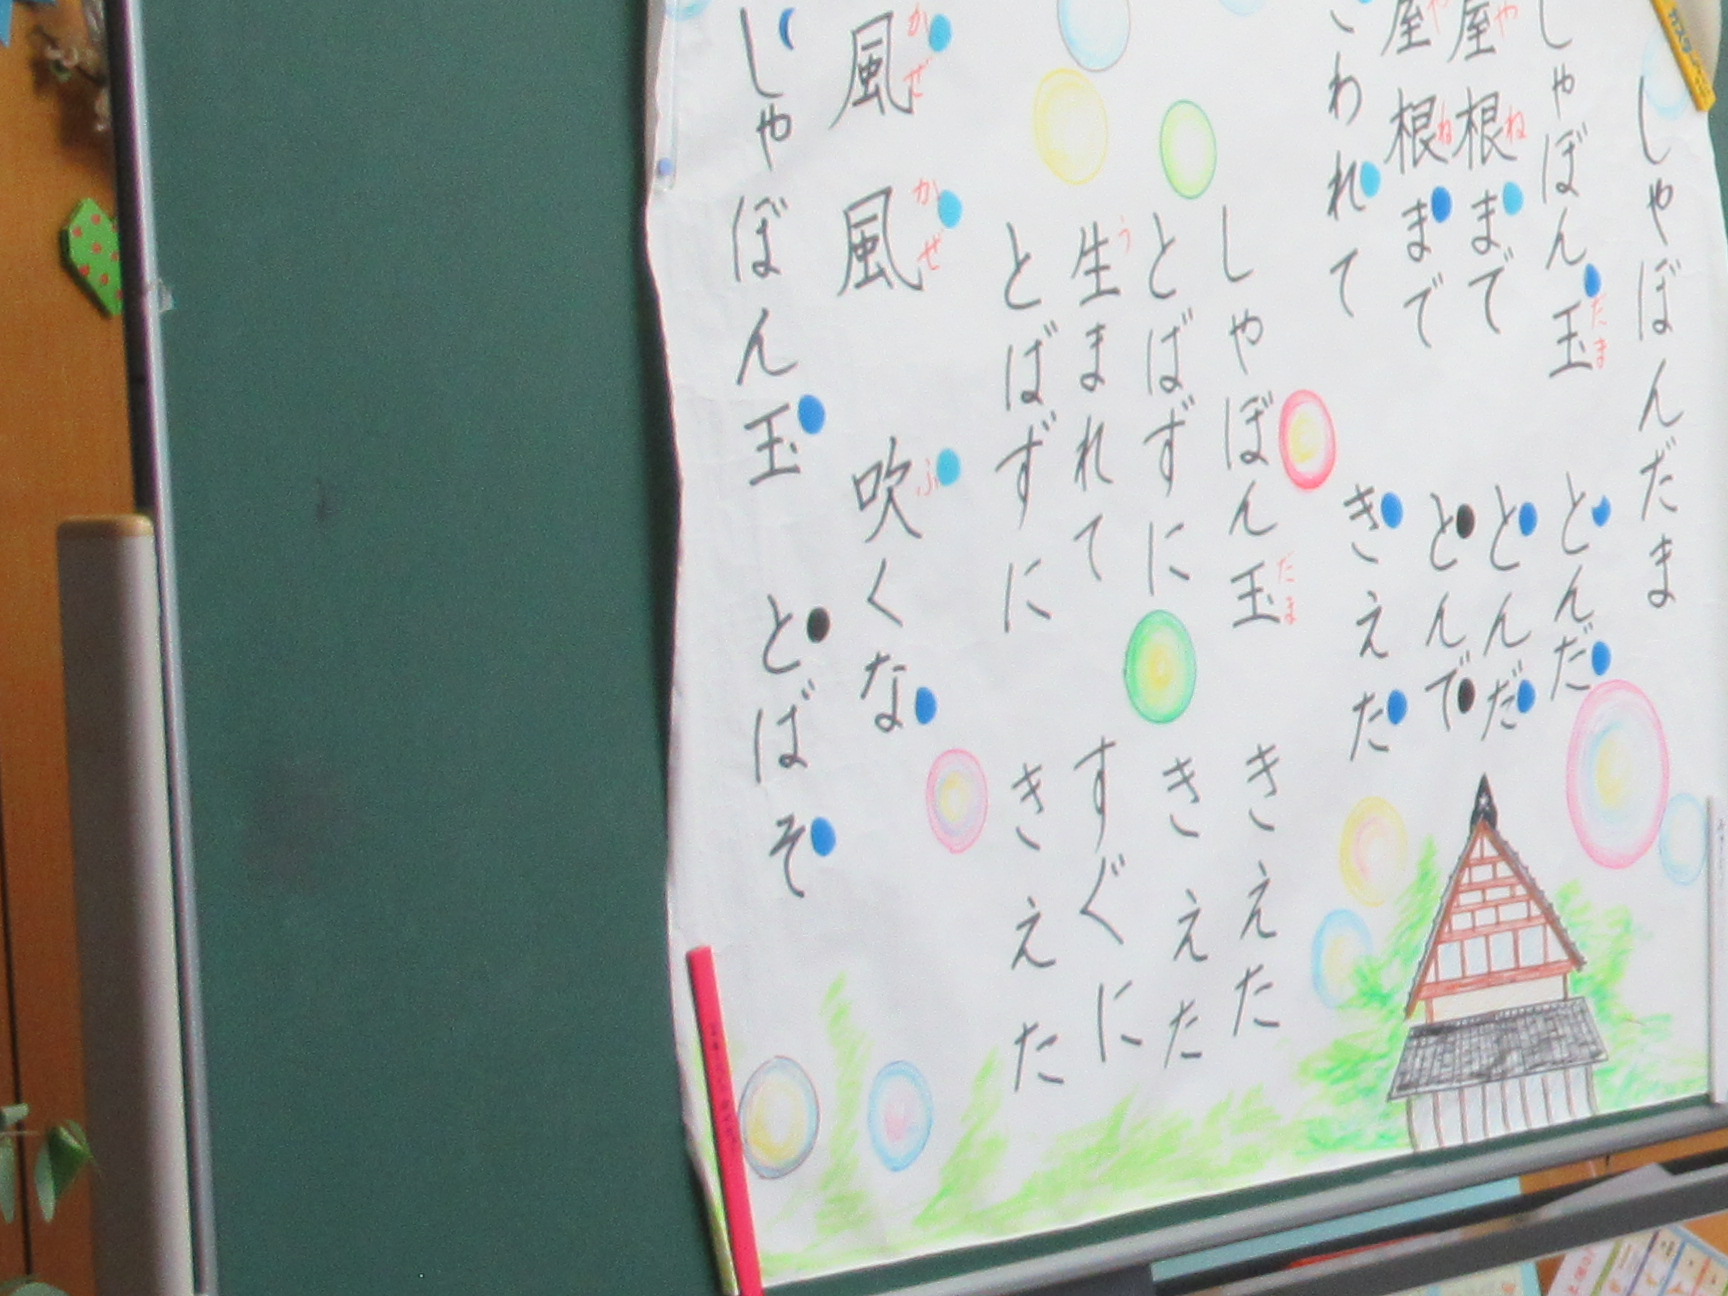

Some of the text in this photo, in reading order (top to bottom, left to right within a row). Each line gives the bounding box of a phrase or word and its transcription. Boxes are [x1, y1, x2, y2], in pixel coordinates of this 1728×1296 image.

[732, 6, 806, 899] しゃぼん玉 とばそ
[828, 10, 924, 733] 風 風 吹くな
[994, 221, 1065, 1093] とばずに きえた
[1070, 220, 1143, 1063] 生まれて すぐに
[1142, 211, 1209, 1069] とばずに きえた
[1222, 205, 1282, 1037] しゃぼん玉 きえた
[1343, 483, 1390, 762] きえた
[1425, 492, 1472, 733] とんで
[1481, 484, 1533, 742] とんだ
[1551, 471, 1595, 702] とんだ
[1637, 74, 1686, 609] しゃぼんだま
